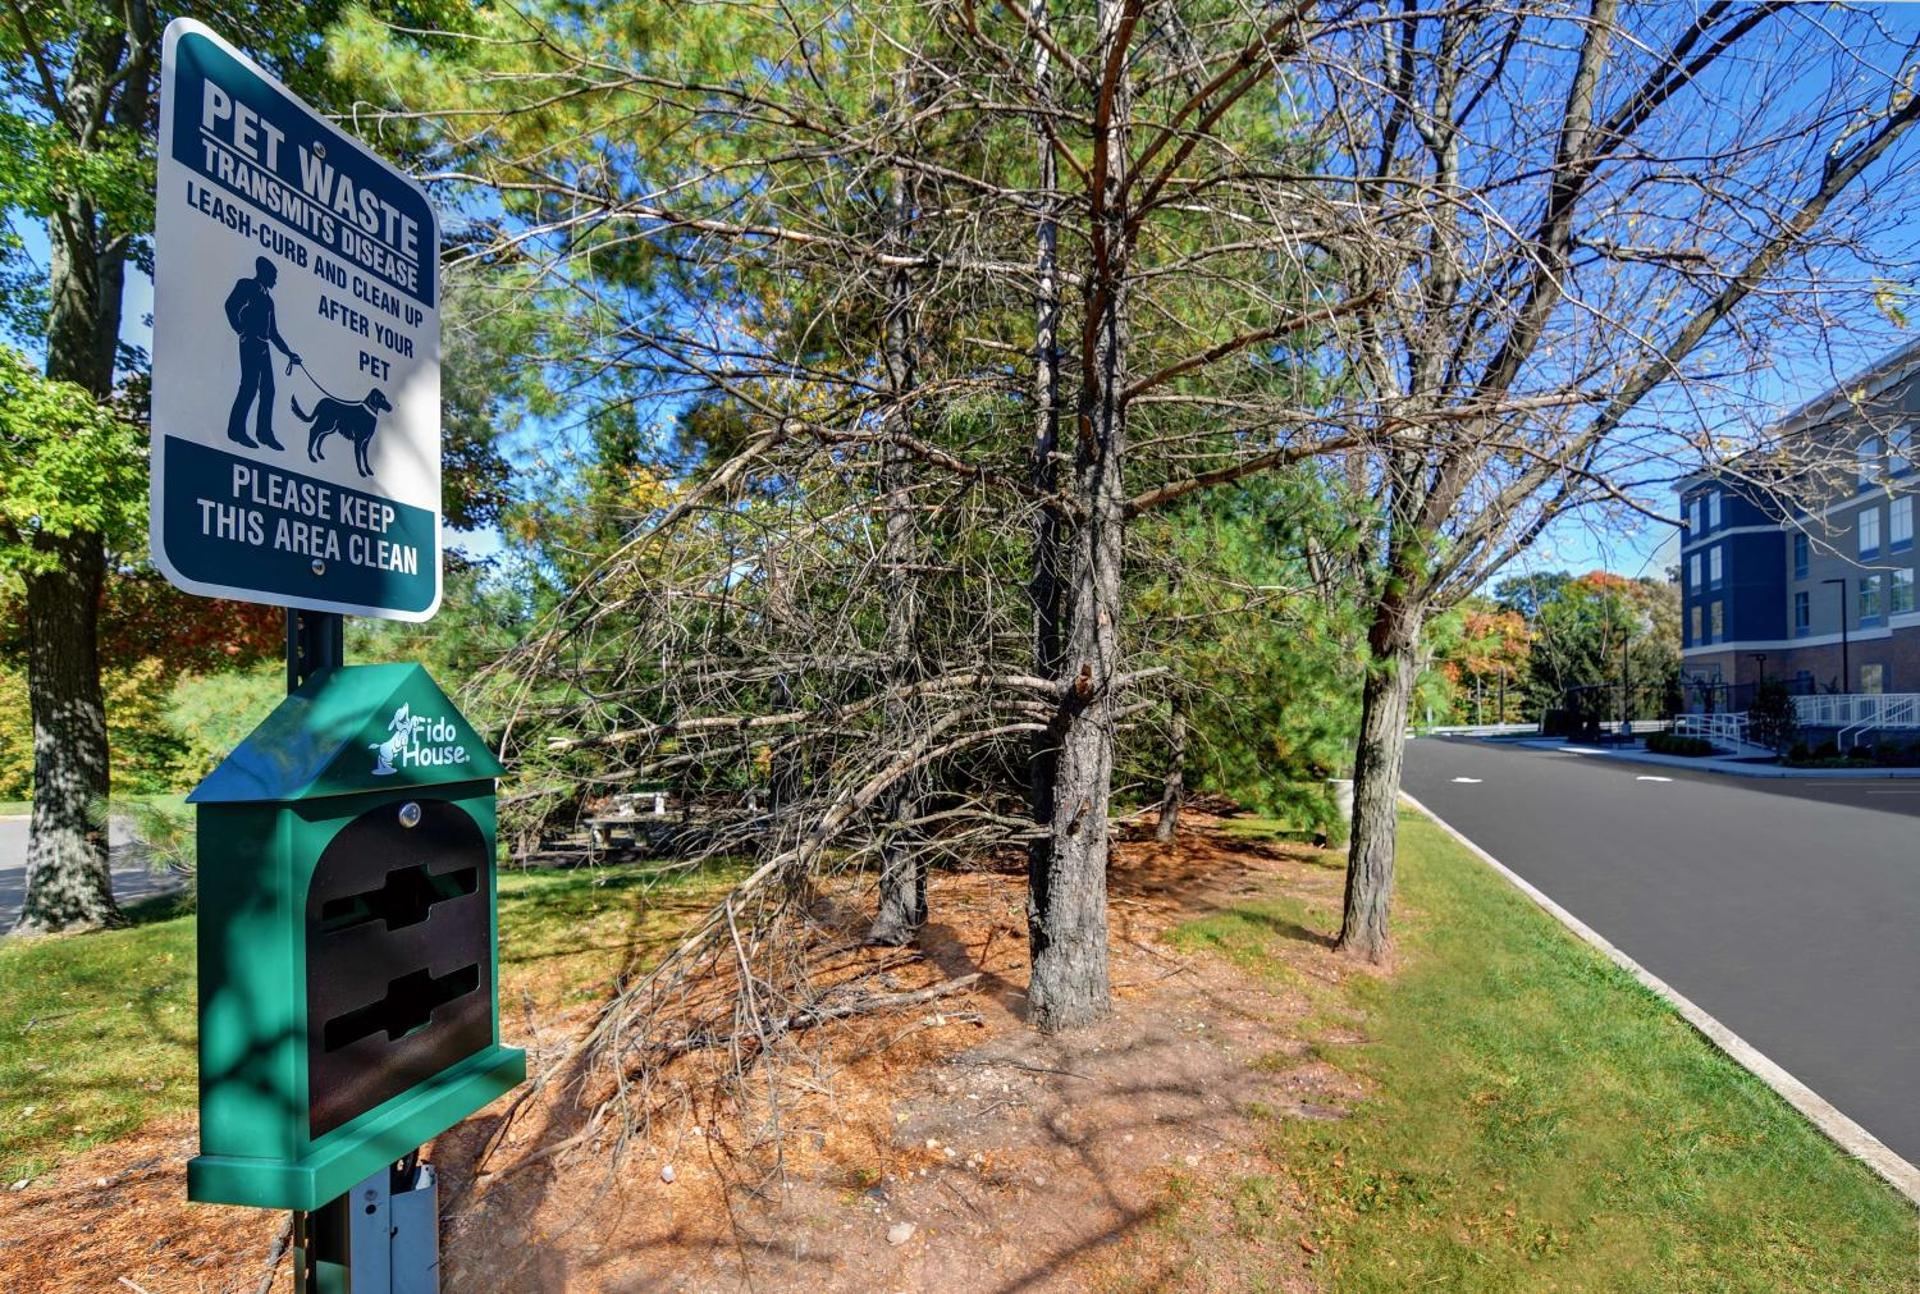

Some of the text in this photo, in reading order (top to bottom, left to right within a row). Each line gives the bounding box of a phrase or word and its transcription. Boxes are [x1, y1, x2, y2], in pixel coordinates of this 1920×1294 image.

[202, 78, 418, 261] PET WASTE
[202, 138, 418, 293] TRANSMITS DISEASE
[187, 181, 423, 328] LEASH-CURB AND CLEAN UP
[318, 295, 413, 358] AFTER YOUR
[359, 350, 390, 382] PET
[233, 463, 395, 533] PLEASE KEEP
[197, 498, 417, 575] THIS AREA CLEAN
[411, 716, 456, 744] Fido
